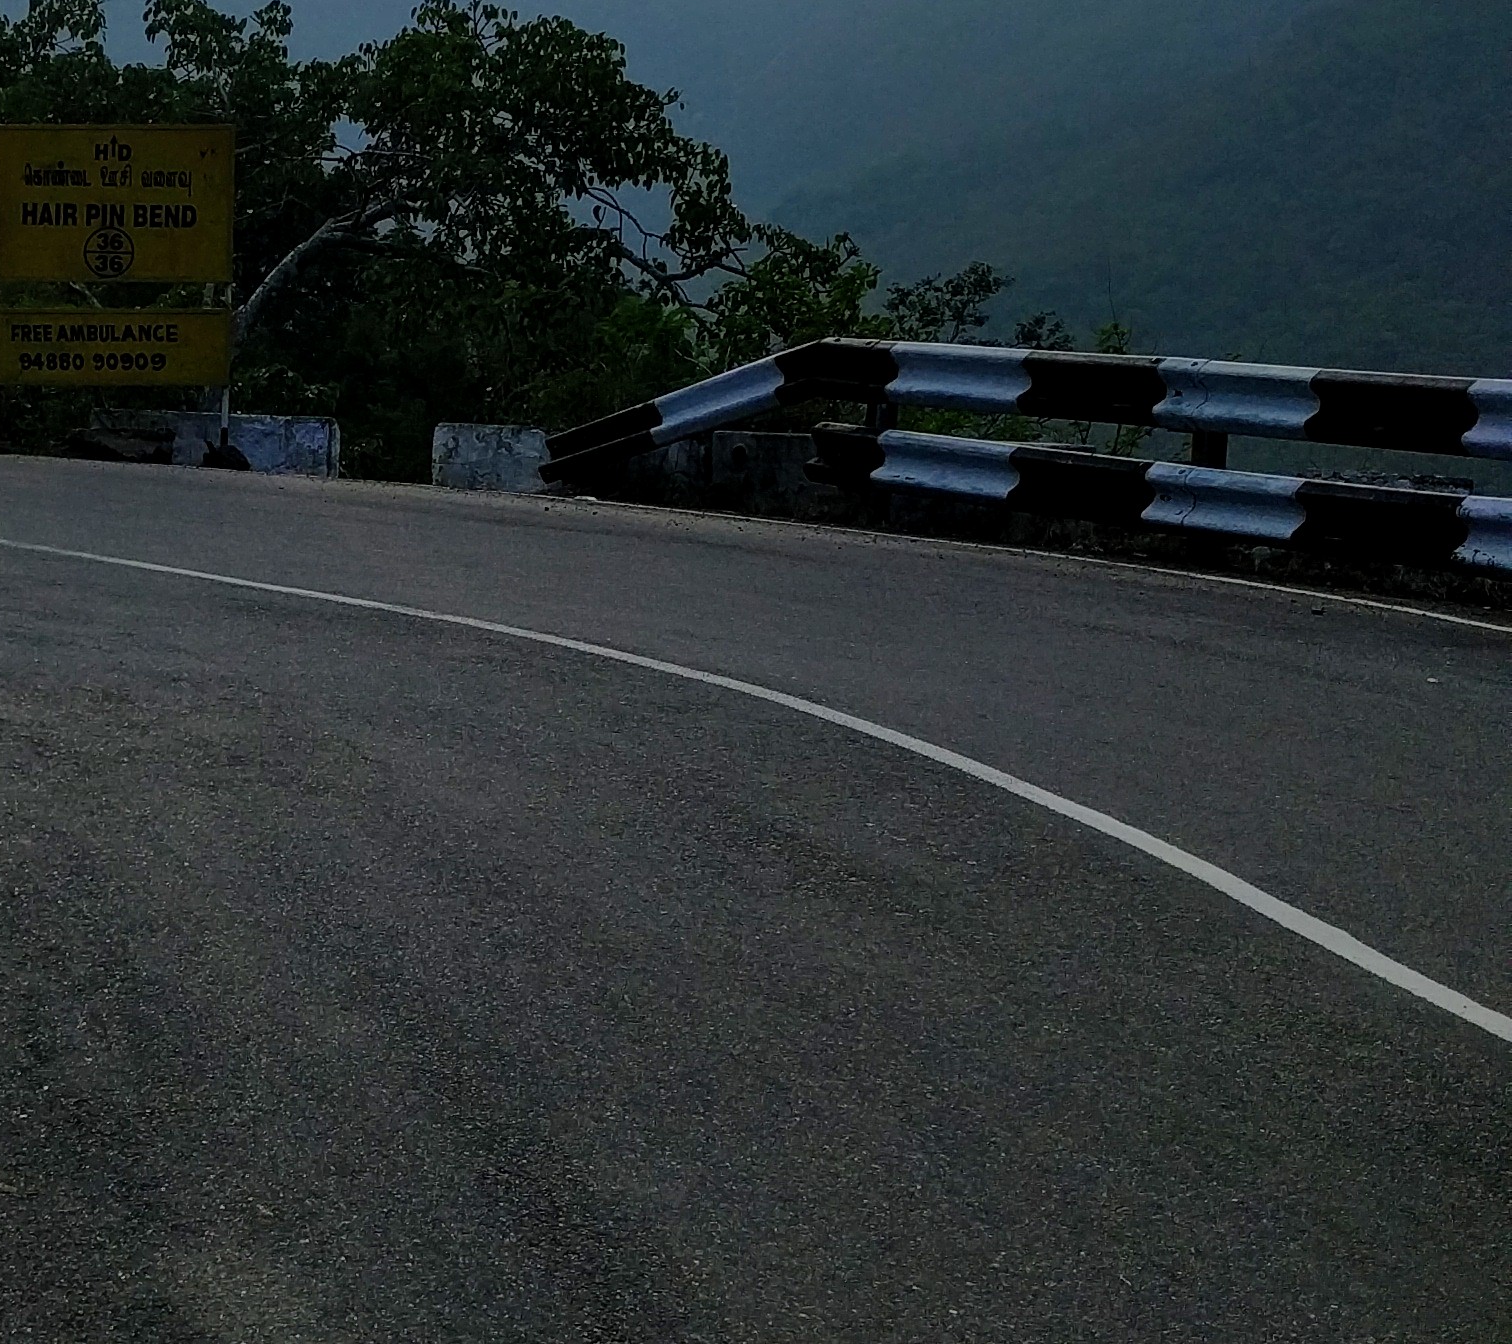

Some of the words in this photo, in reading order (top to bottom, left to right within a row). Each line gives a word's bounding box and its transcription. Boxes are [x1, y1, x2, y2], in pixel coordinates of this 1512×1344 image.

[100, 164, 132, 186] ஊசி
[22, 203, 77, 226] HAIR
[85, 204, 125, 226] PIN
[133, 204, 197, 227] BEND
[96, 233, 124, 250] 36
[95, 256, 124, 272] 36
[11, 324, 52, 342] FREE
[57, 324, 178, 342] AMBULANCE
[19, 353, 84, 370] 94880
[92, 353, 167, 371] 90909
